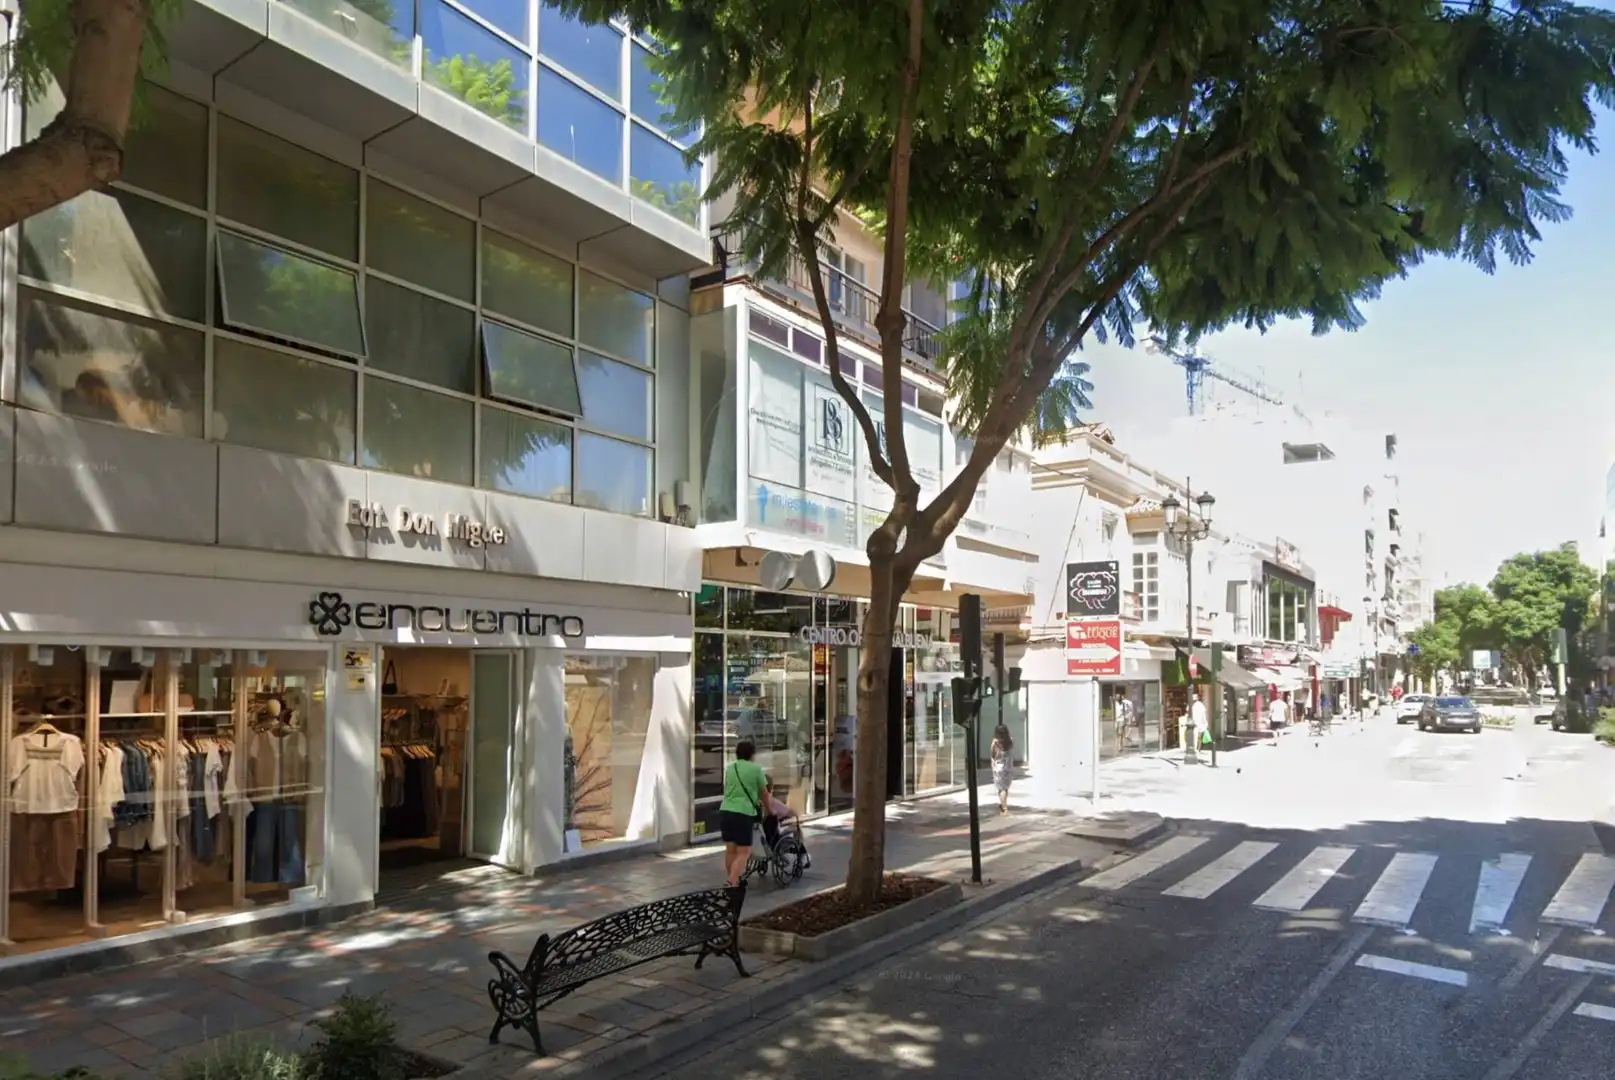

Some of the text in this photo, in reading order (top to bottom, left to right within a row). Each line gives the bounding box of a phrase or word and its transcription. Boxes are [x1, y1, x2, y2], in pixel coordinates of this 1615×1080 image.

[398, 505, 437, 536] Don
[355, 601, 584, 638] encuentro
[800, 625, 846, 646] CENTRO
[892, 631, 933, 649] ALBUENA
